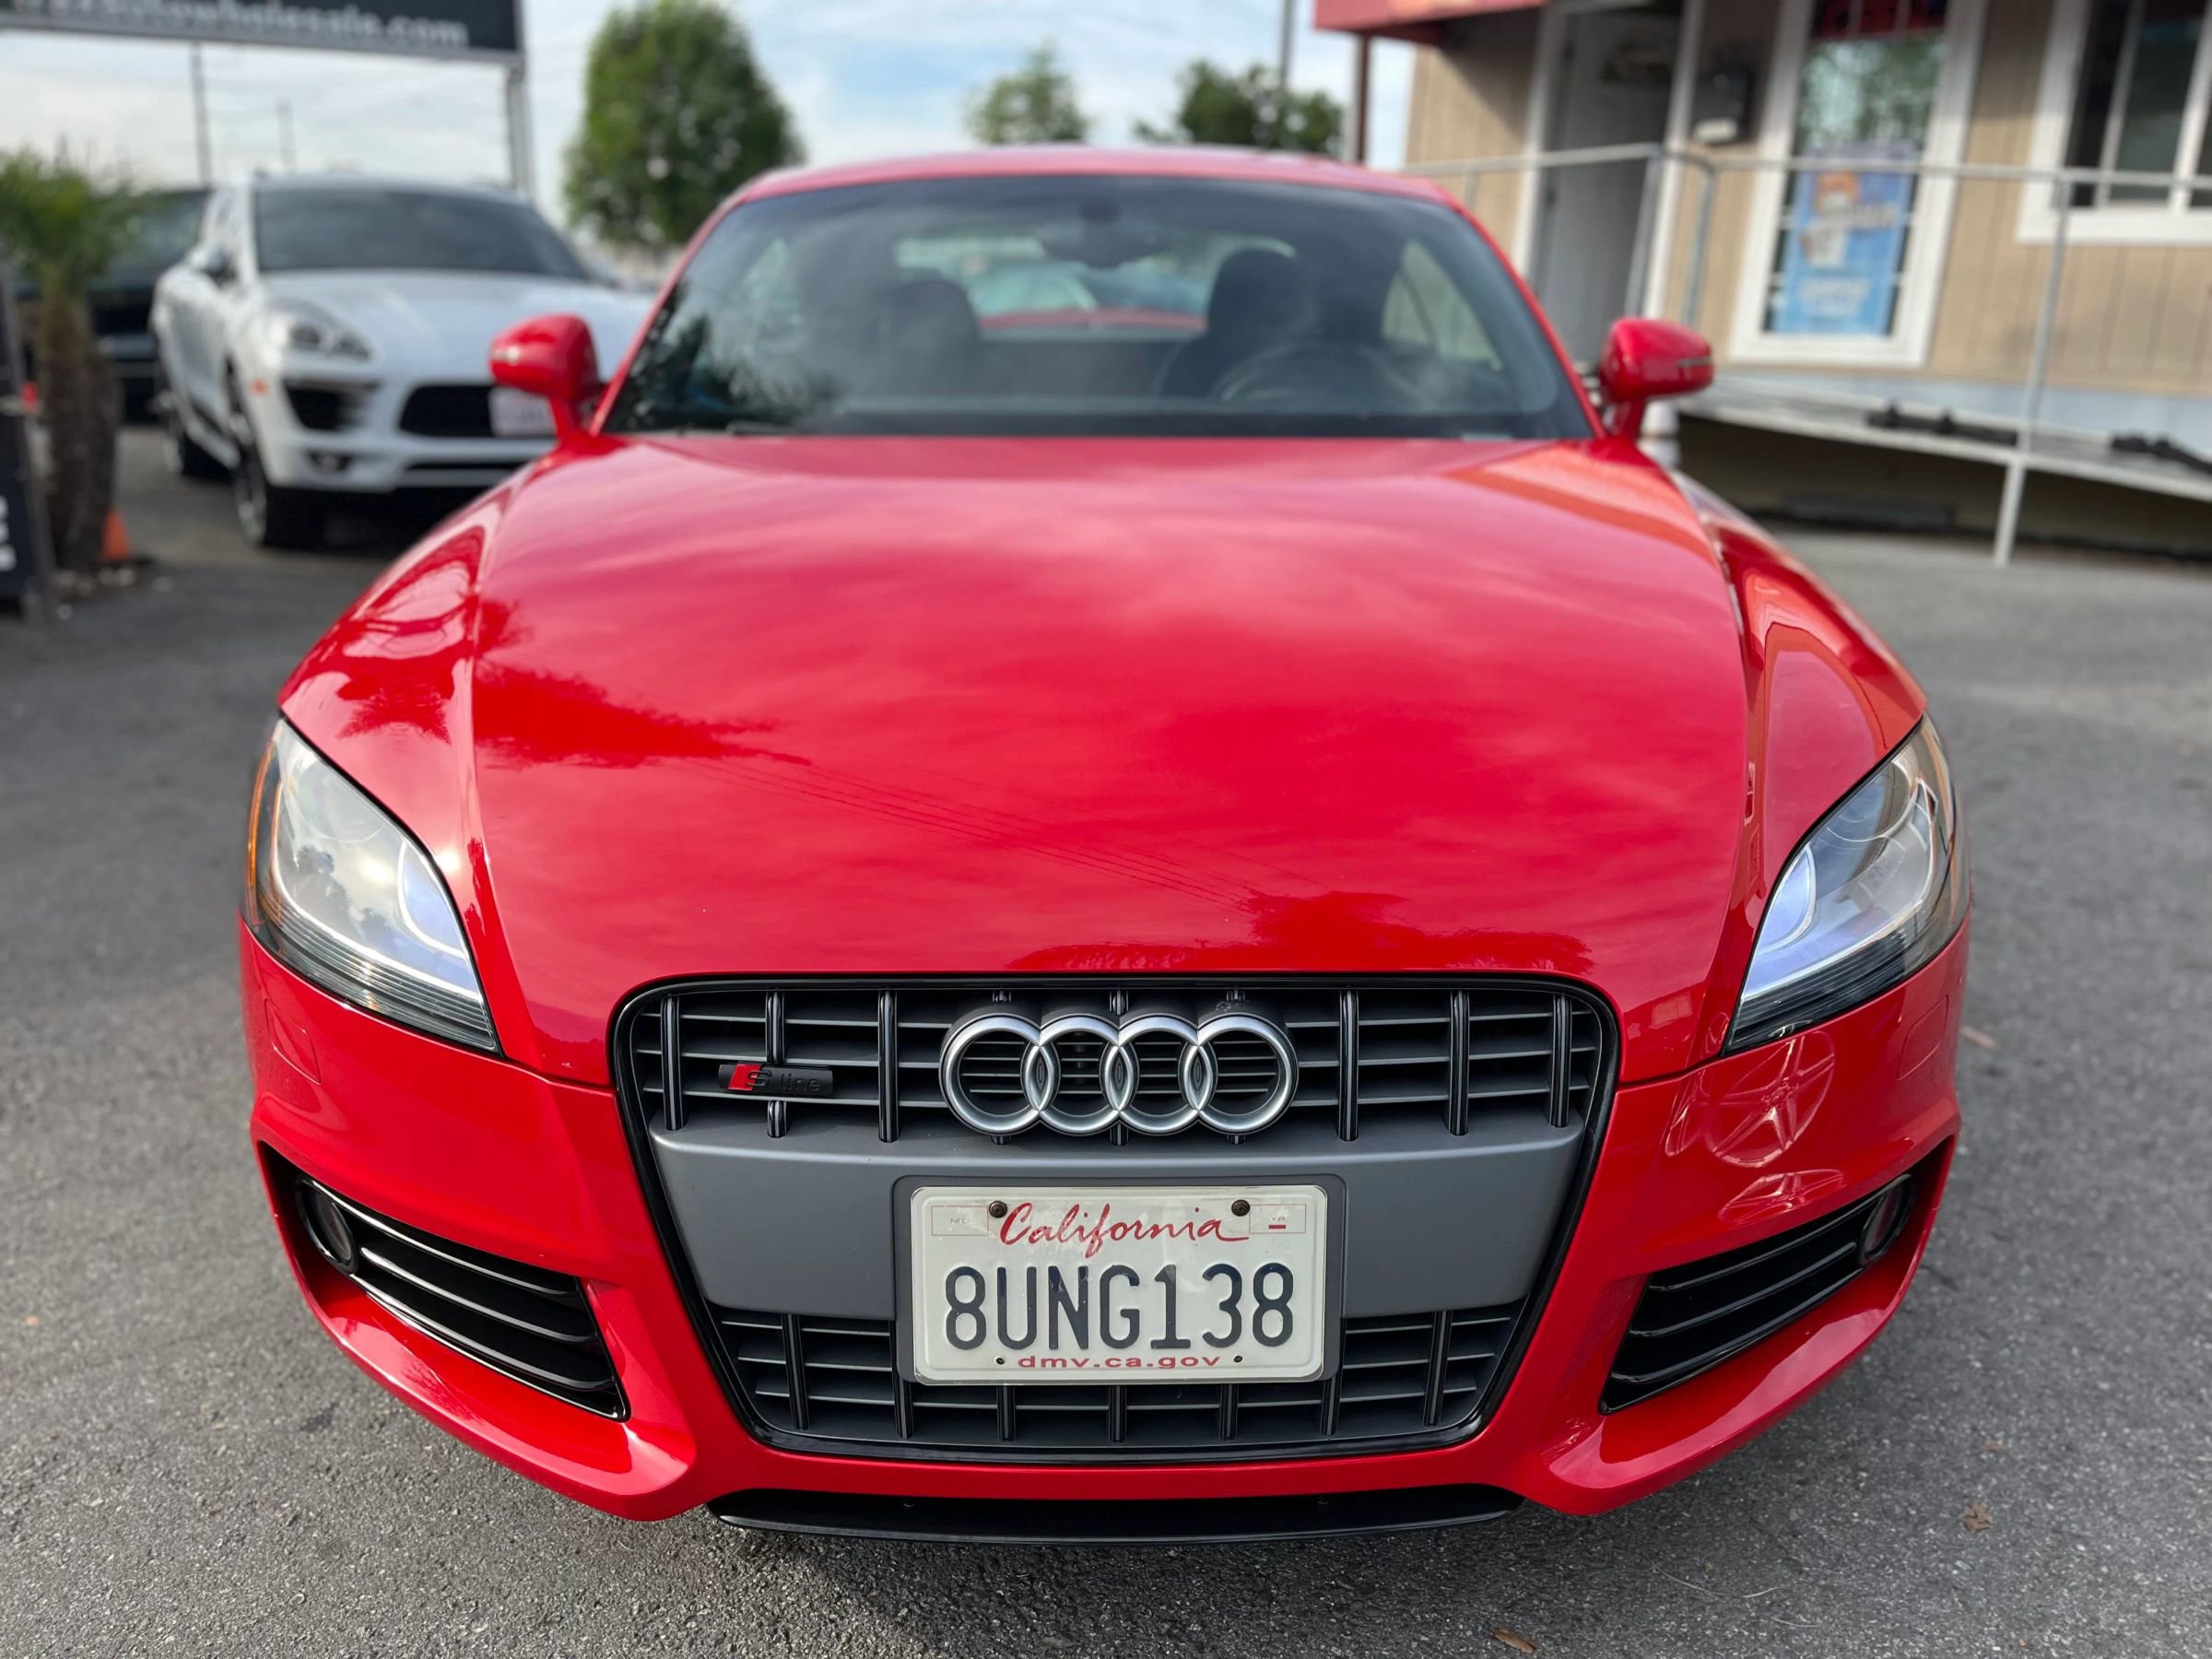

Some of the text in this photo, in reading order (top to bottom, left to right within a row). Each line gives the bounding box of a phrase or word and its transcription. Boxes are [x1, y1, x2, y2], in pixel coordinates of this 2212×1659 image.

[781, 1073, 820, 1092] line
[1000, 1202, 1249, 1258] California
[945, 1262, 1294, 1350] 8UNG138
[1018, 1354, 1221, 1370] dmv.ca.gov
